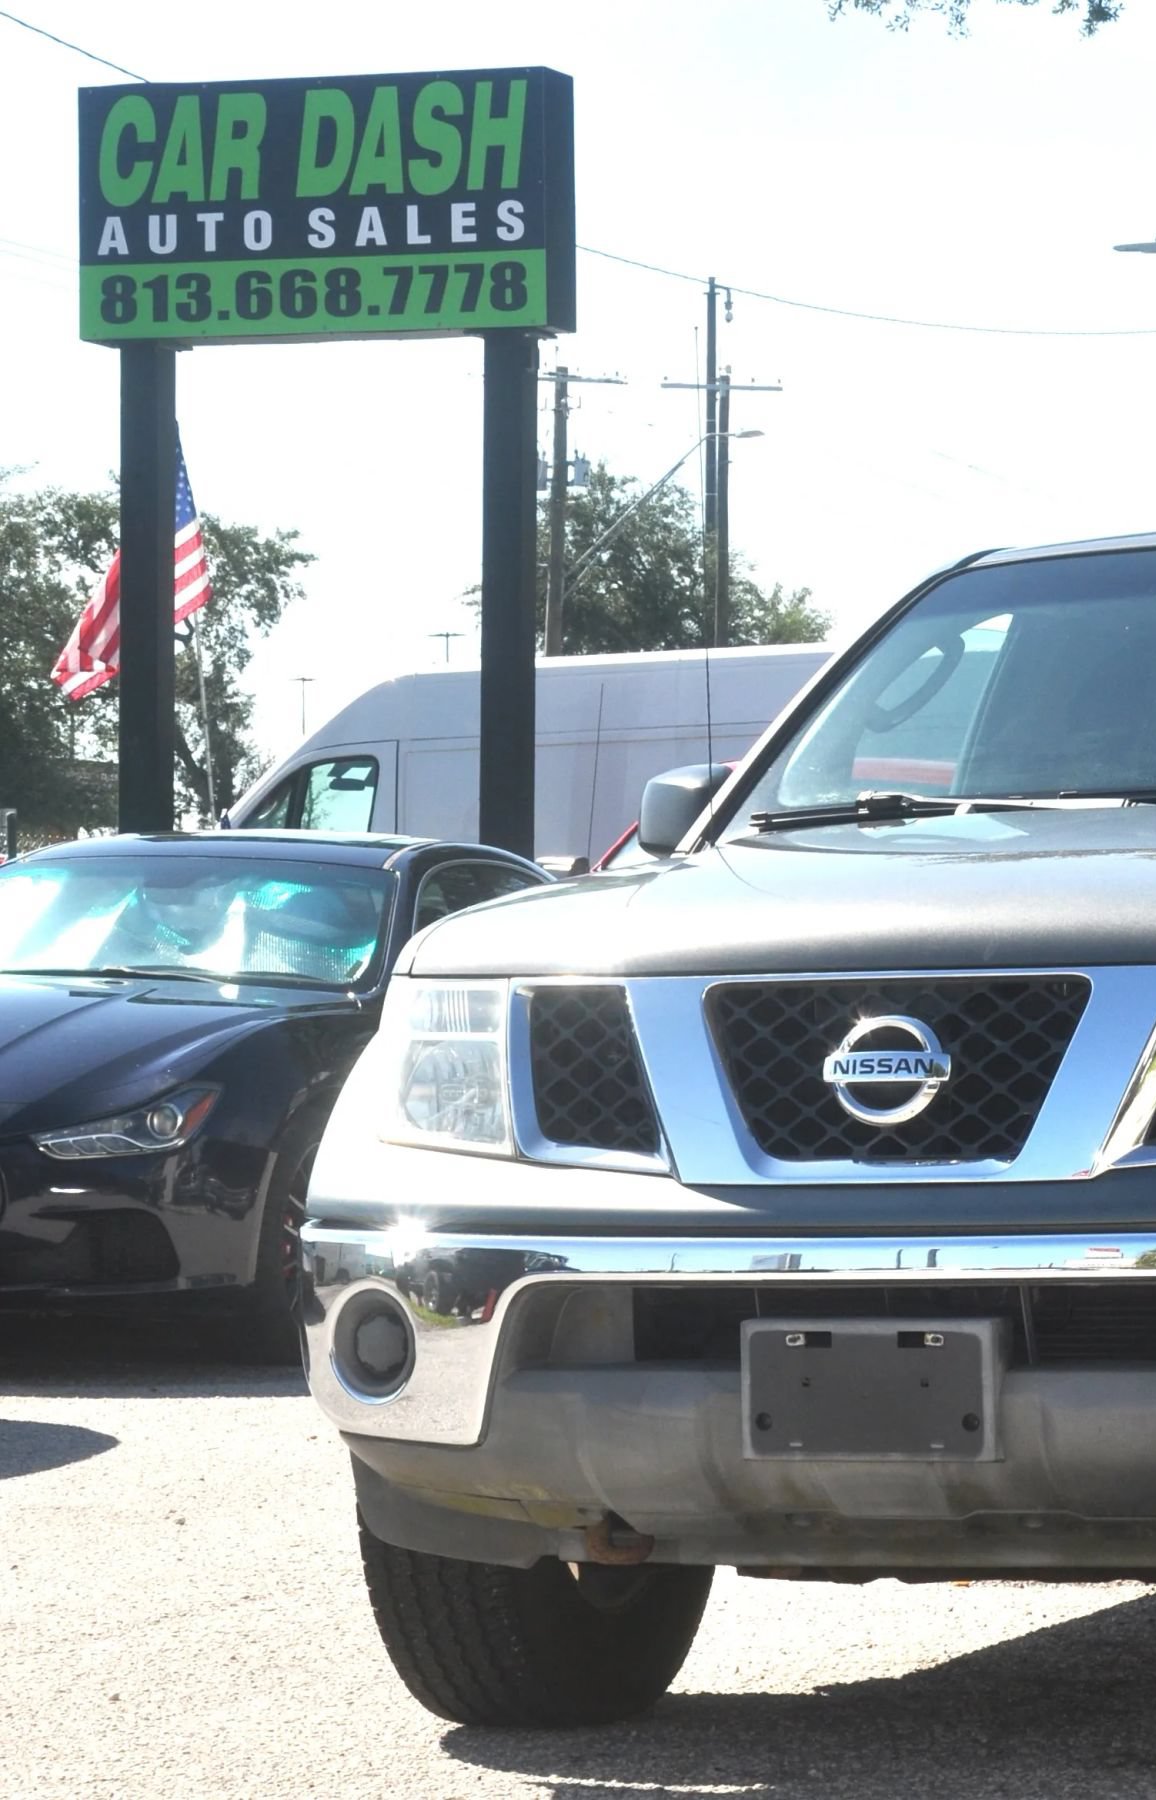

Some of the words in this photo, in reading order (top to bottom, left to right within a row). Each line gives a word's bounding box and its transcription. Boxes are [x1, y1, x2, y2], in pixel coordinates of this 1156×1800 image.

[98, 92, 267, 207] CAR
[296, 79, 527, 197] DASH
[98, 210, 272, 255] AUTO
[308, 199, 525, 249] SALES
[101, 261, 527, 324] 813.668.7778
[833, 1058, 934, 1075] NISSAN
